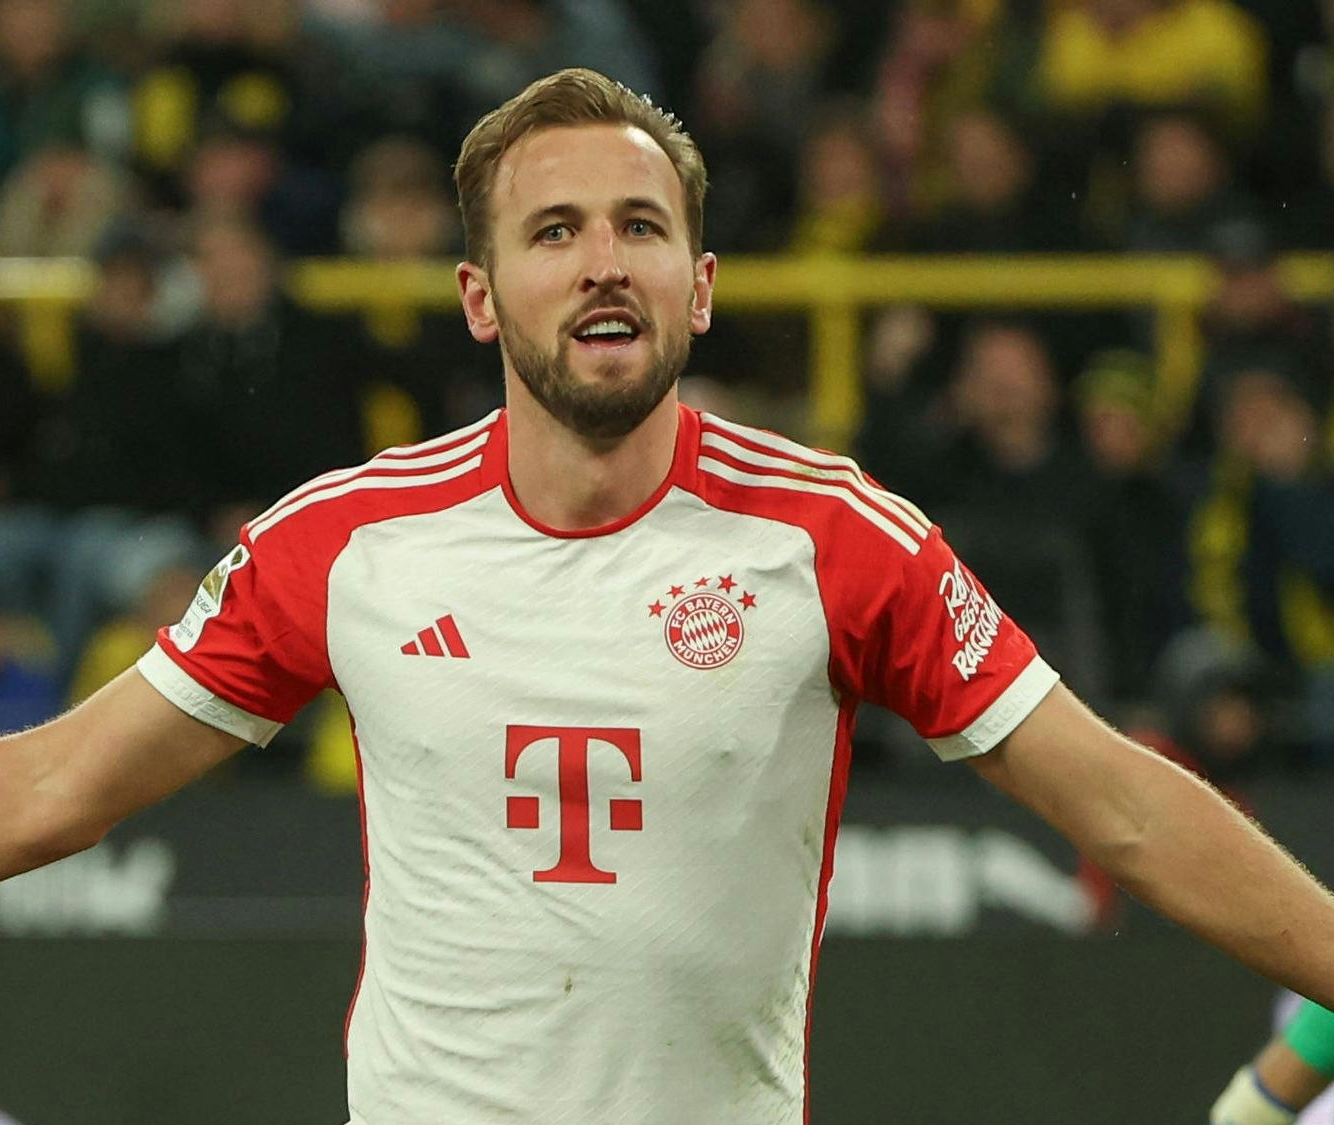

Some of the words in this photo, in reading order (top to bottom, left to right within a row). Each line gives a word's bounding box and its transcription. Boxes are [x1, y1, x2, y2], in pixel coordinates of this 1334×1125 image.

[671, 610, 686, 628] FC
[685, 598, 736, 624] BAYERN
[506, 725, 643, 884] T
